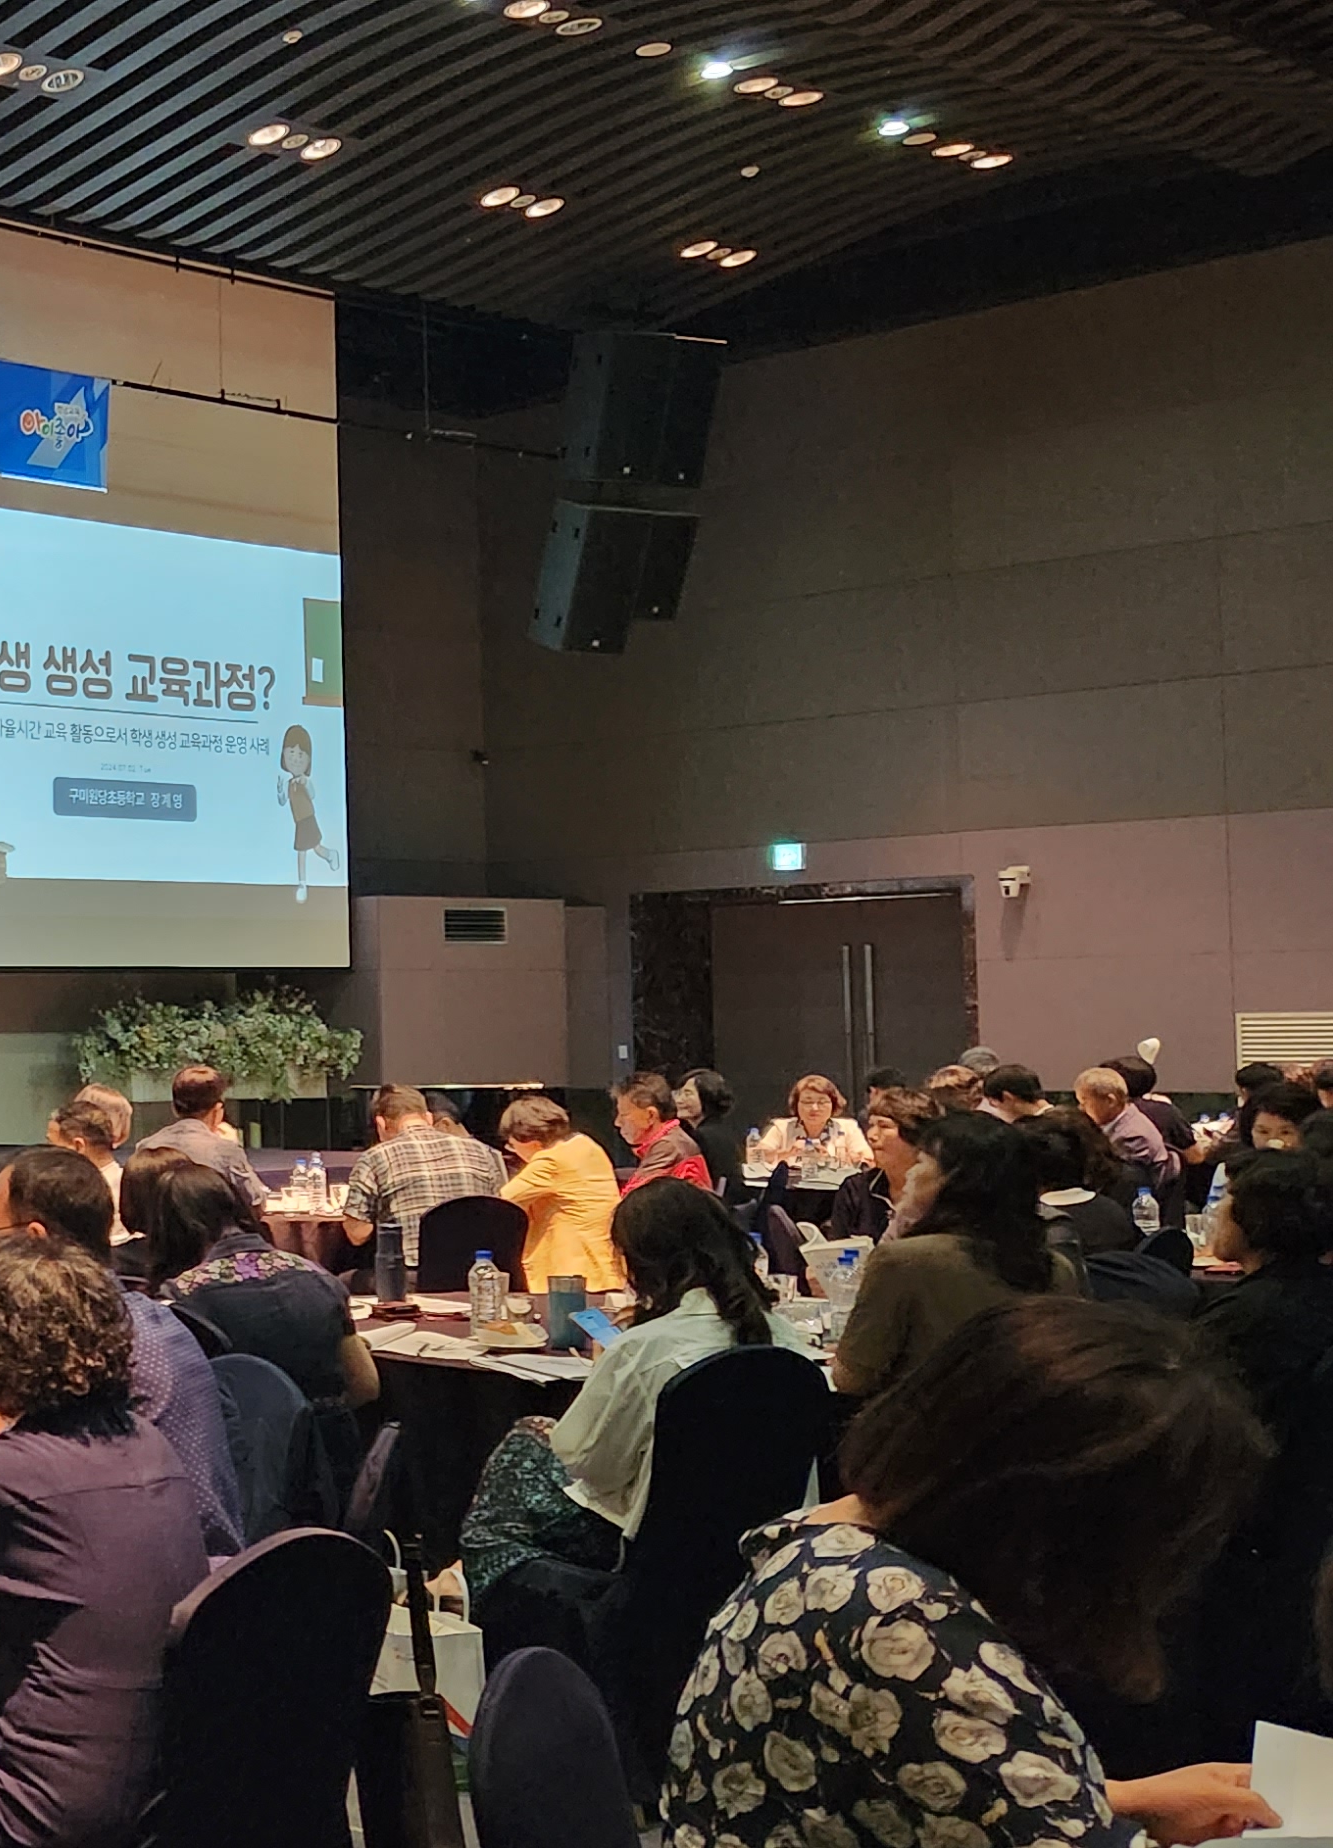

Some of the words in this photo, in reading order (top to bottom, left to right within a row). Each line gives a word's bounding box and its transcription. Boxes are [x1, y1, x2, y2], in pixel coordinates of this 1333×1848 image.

[43, 644, 113, 699] 생성
[125, 653, 276, 711] 교육과정?
[44, 722, 68, 742] 교육
[69, 723, 128, 746] 활동으로서
[130, 727, 152, 748] 학생
[155, 731, 177, 750] 생성
[180, 732, 223, 753] 교육과정
[225, 735, 247, 754] 운영
